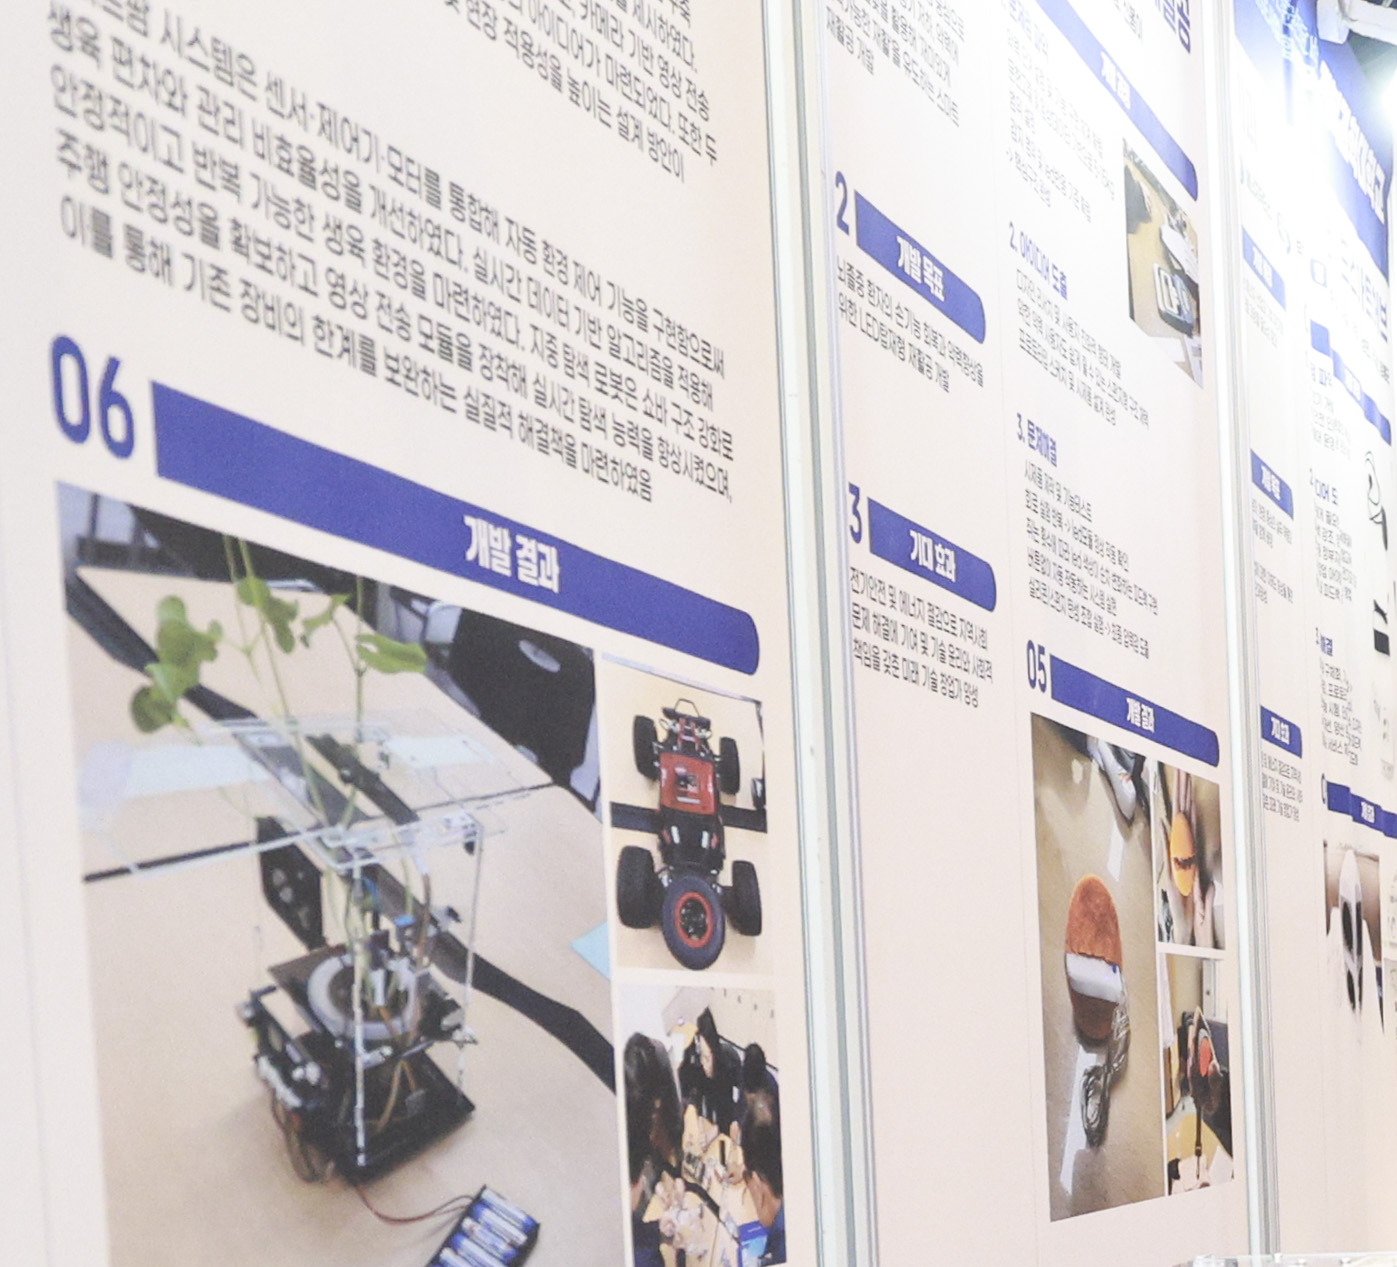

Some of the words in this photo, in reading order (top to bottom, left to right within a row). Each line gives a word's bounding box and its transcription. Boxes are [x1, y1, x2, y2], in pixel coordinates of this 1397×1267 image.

[502, 16, 563, 92] 적용성을
[566, 68, 612, 128] 높이는
[615, 106, 644, 150] 설계
[646, 128, 684, 182] 방안이
[604, 53, 675, 133] 마련되었다.
[677, 111, 702, 156] 또한
[704, 132, 718, 166] 두
[627, 28, 654, 77] 기반
[656, 53, 682, 99] 영상
[684, 76, 710, 122] 전송
[252, 124, 362, 213] 비효율성을
[369, 184, 467, 271] 개선하였다.
[472, 247, 522, 303] 실시간
[525, 275, 570, 329] 데이터
[573, 304, 602, 351] 기반
[606, 324, 674, 389] 알고리즘을
[676, 363, 713, 411] 적용해
[448, 181, 499, 242] 통합해
[504, 216, 537, 265] 자동
[541, 239, 569, 286] 환경
[571, 259, 601, 306] 제어
[606, 280, 649, 333] 기능을
[652, 307, 724, 378] 구현함으로써
[835, 170, 850, 236] 2
[312, 314, 377, 377] 한계를
[383, 349, 457, 413] 보완하는
[463, 386, 513, 438] 실질적
[517, 412, 577, 469] 해결책을
[580, 441, 652, 502] 마련하였음
[322, 214, 365, 265] 생육
[372, 237, 426, 300] 환경을
[432, 271, 524, 350] 마련하였다.
[561, 341, 590, 386] 탐색
[593, 360, 638, 412] 로봇은
[670, 400, 695, 441] 구조
[697, 416, 734, 461] 강화로
[324, 266, 369, 320] 영상
[375, 289, 412, 342] 전송
[417, 313, 473, 372] 모듈을
[478, 342, 527, 398] 장착해
[532, 373, 575, 423] 실시간
[577, 395, 607, 438] 탐색
[611, 413, 654, 461] 능력을
[51, 334, 135, 460] 06
[463, 514, 510, 575] 개발
[515, 534, 561, 593] 결과
[848, 481, 863, 545] 3
[1026, 639, 1048, 694] 05
